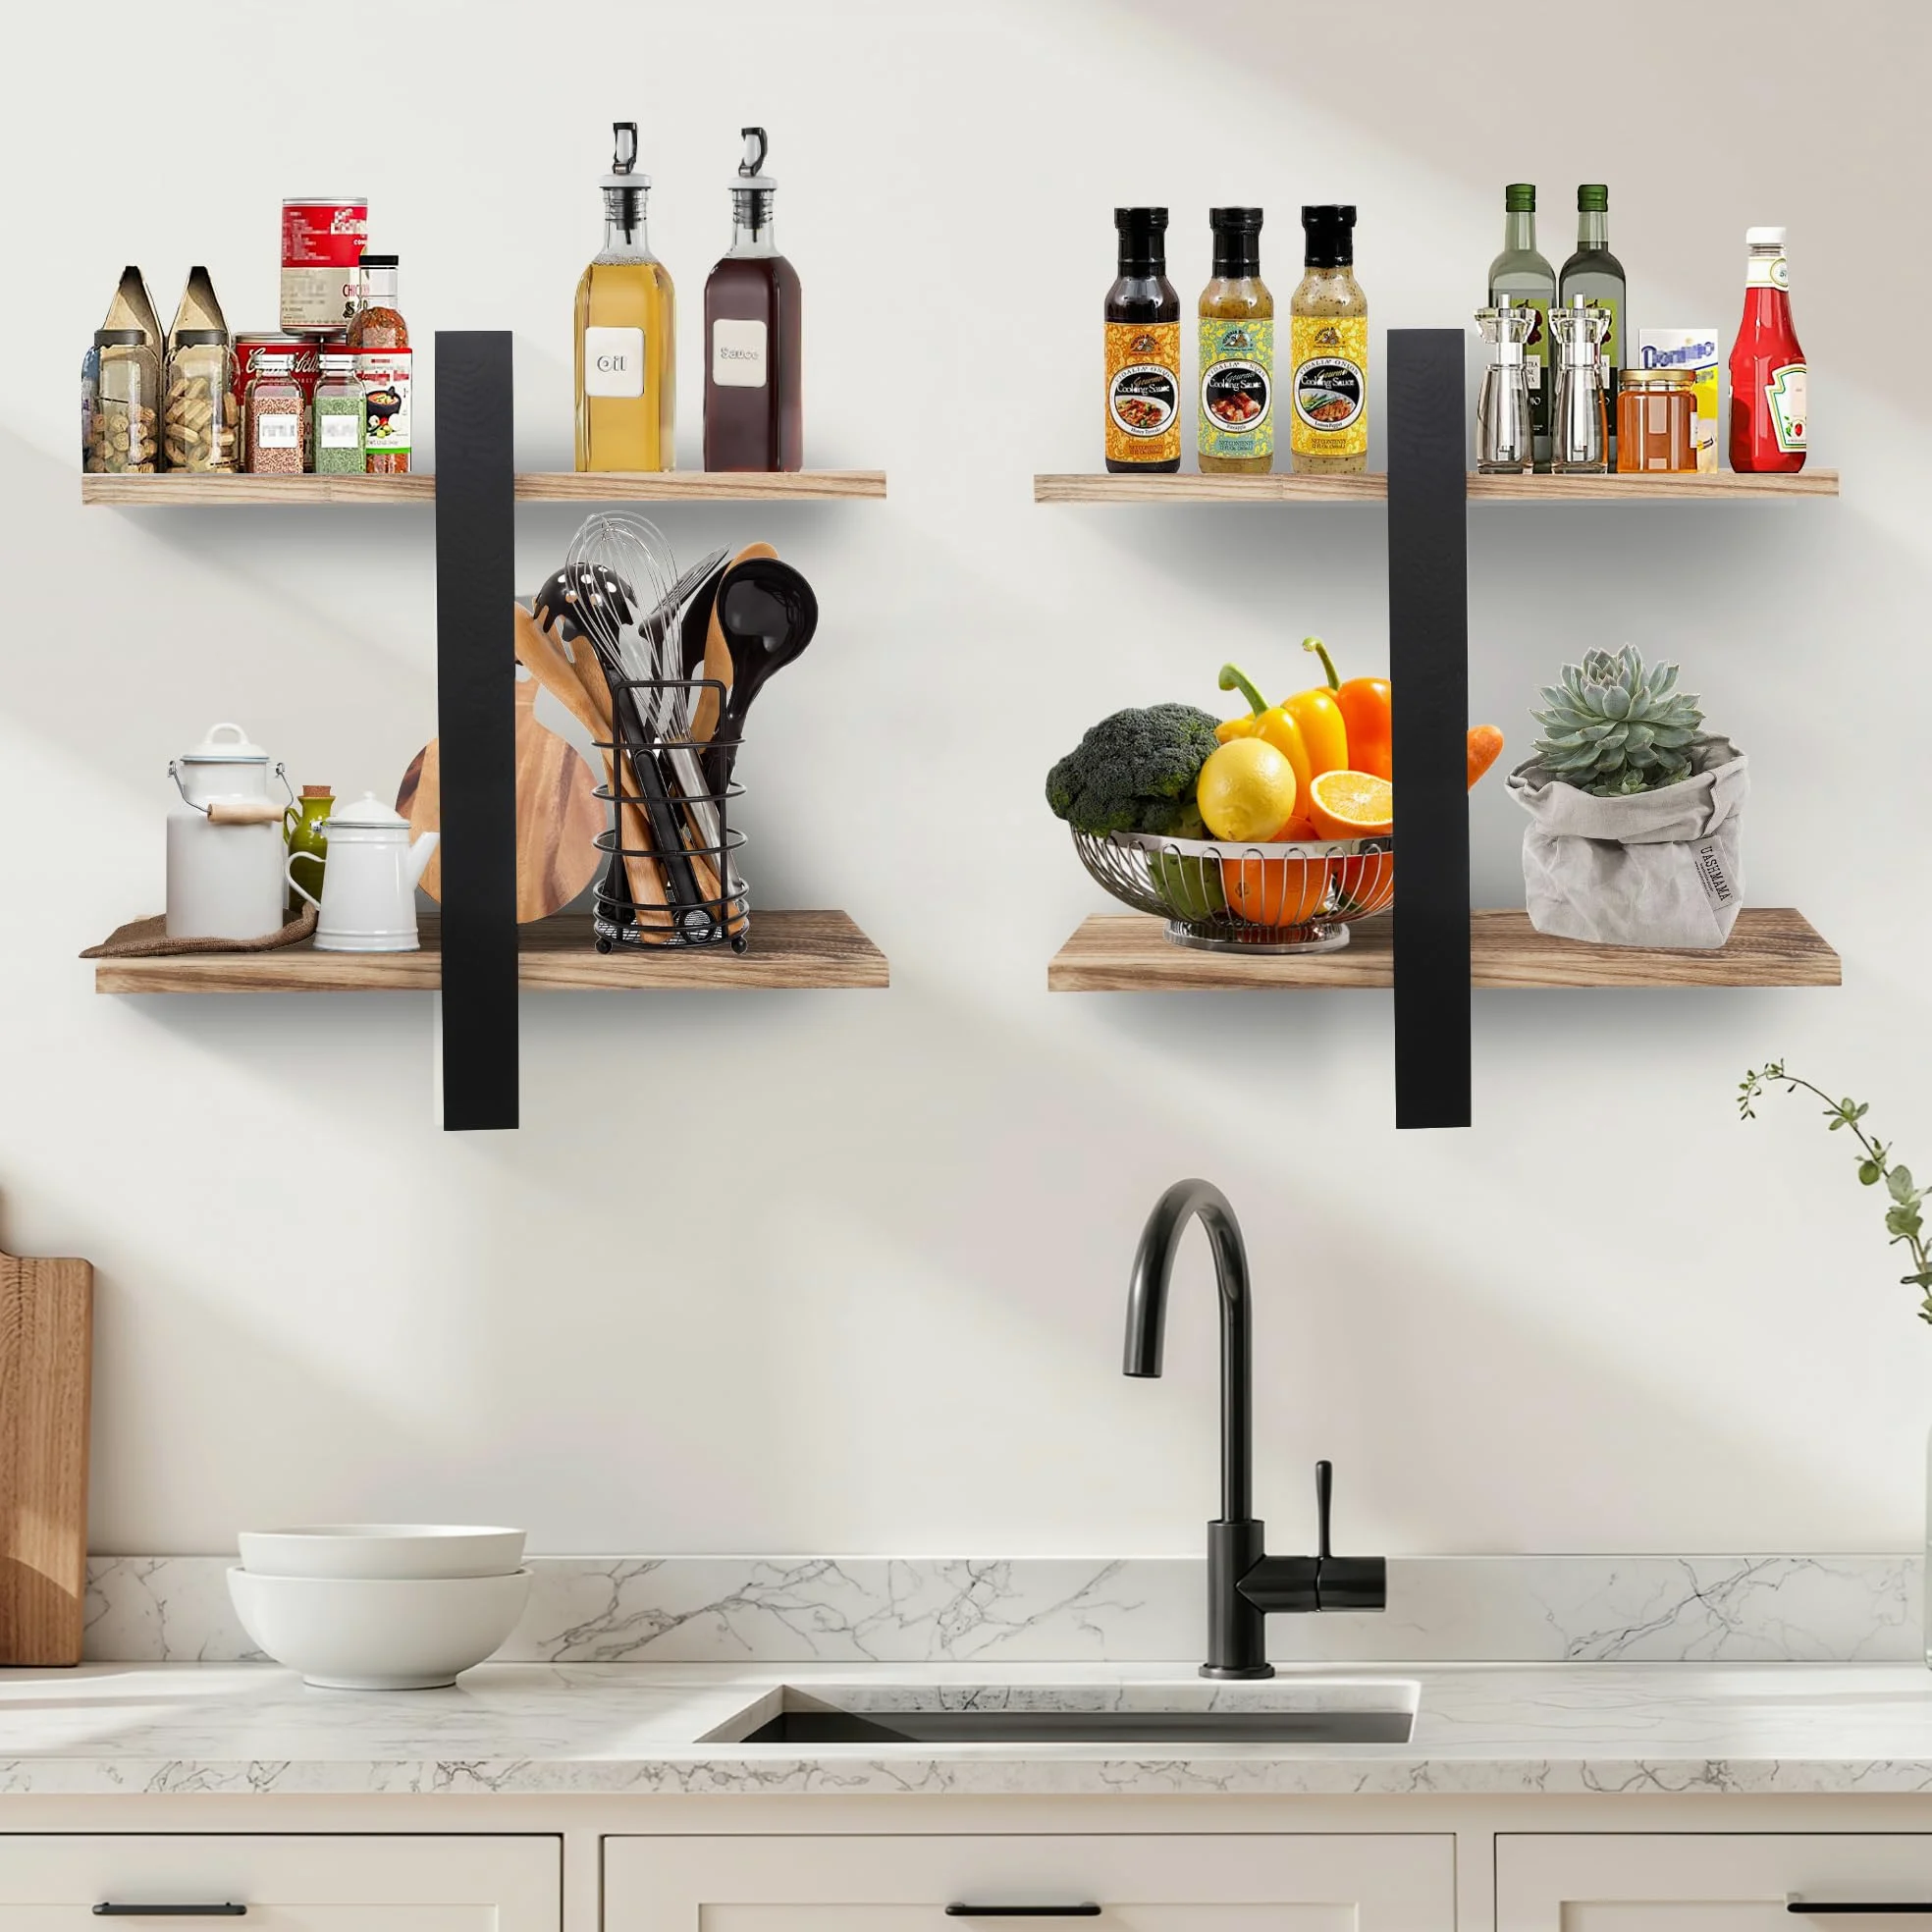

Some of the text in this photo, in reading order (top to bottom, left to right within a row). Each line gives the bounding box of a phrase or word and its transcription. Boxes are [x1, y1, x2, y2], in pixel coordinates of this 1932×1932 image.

[721, 347, 760, 360] Sauce
[597, 354, 627, 372] Oil
[1700, 846, 1732, 901] UASHMAMA
